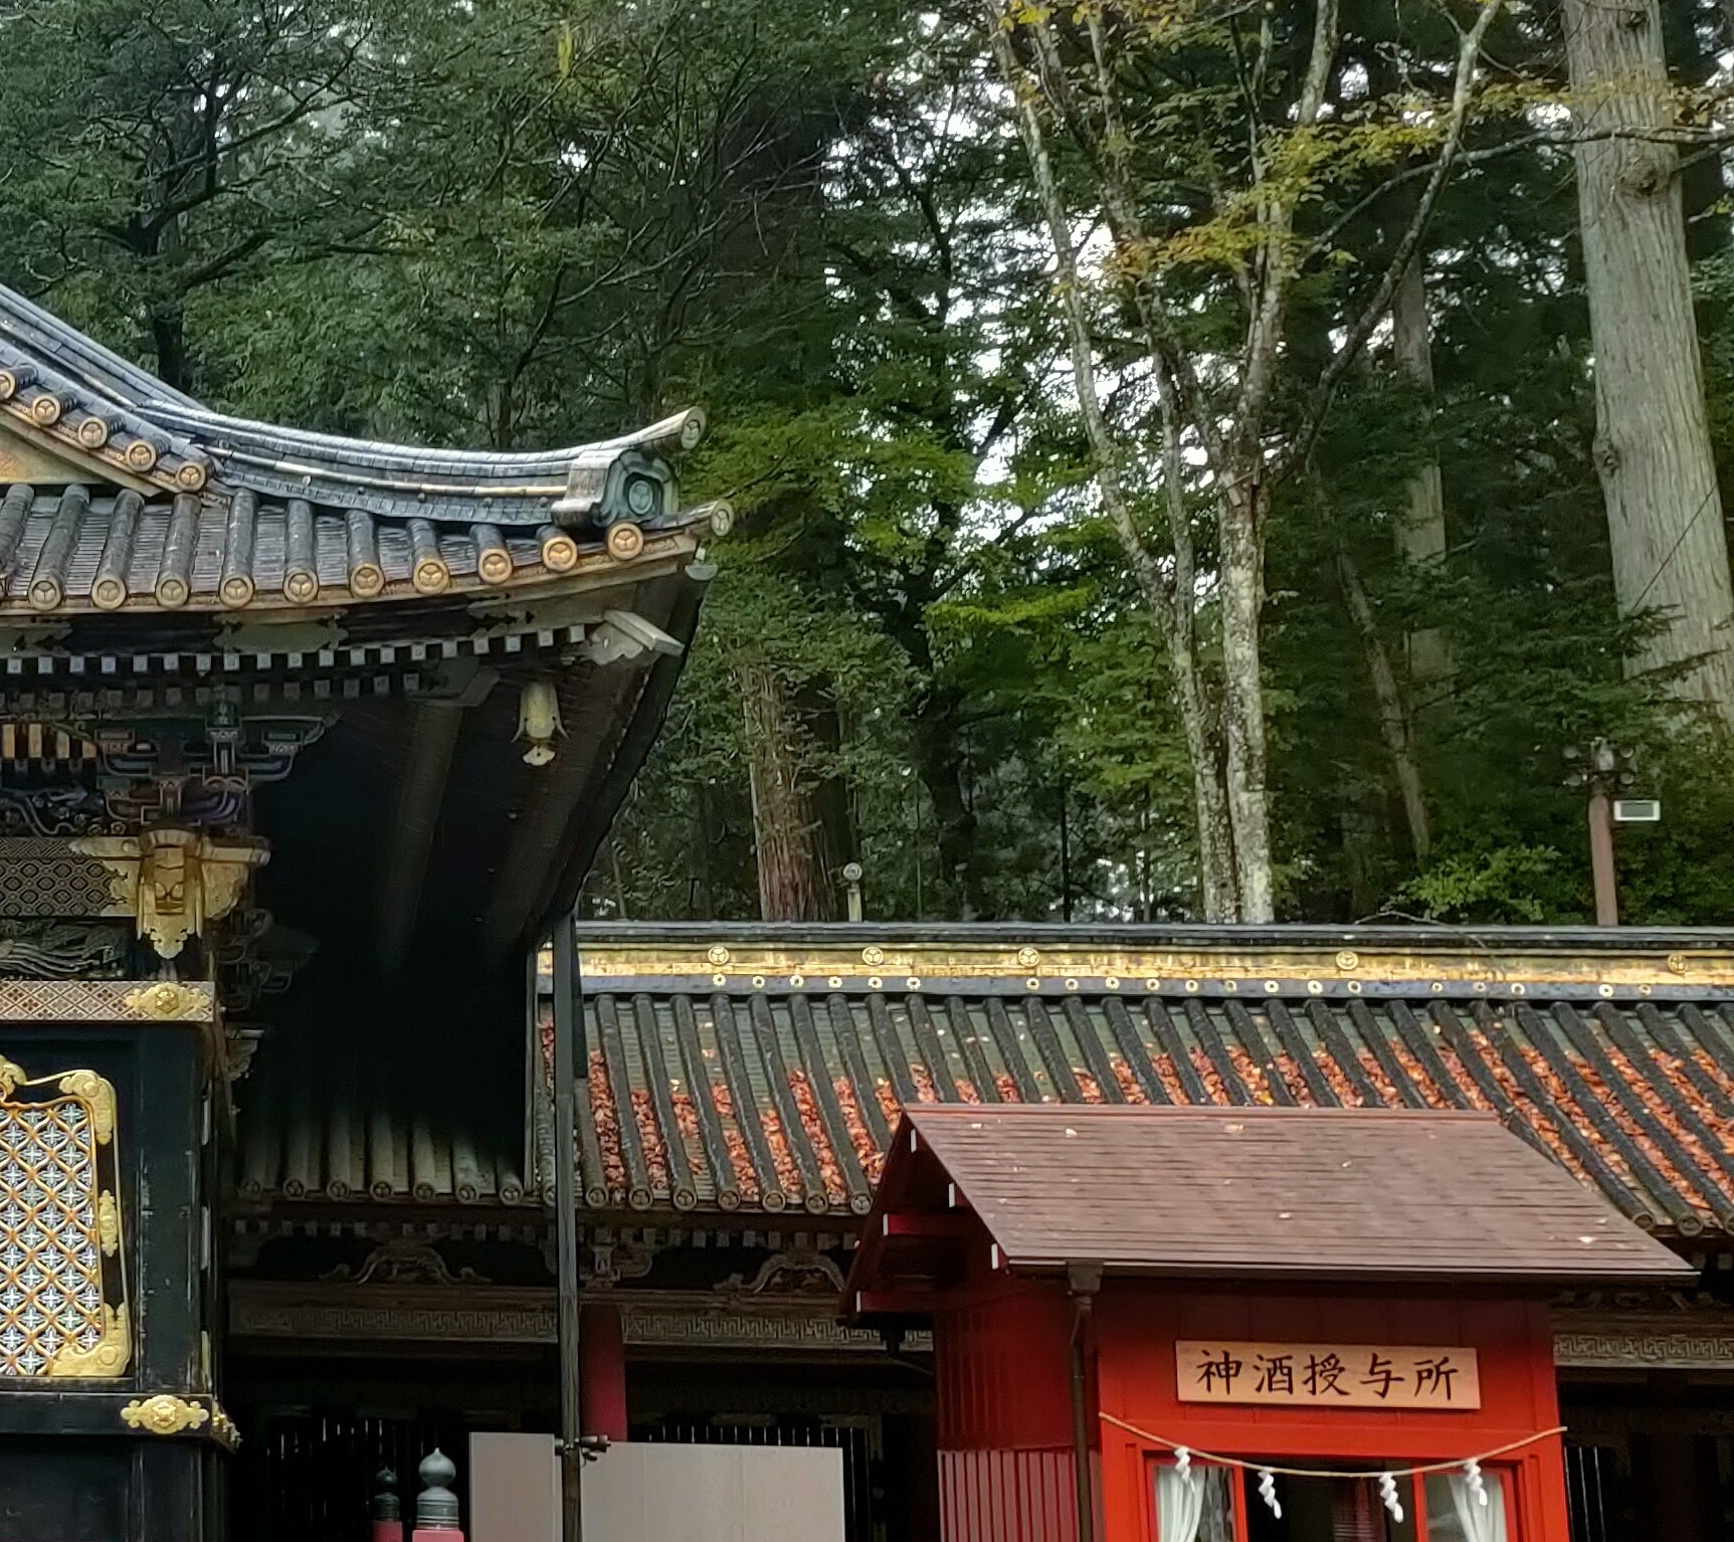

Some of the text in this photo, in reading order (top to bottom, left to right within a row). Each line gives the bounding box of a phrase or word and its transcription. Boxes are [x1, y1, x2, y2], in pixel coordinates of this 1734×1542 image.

[1196, 1350, 1459, 1400] 神酒授与所
